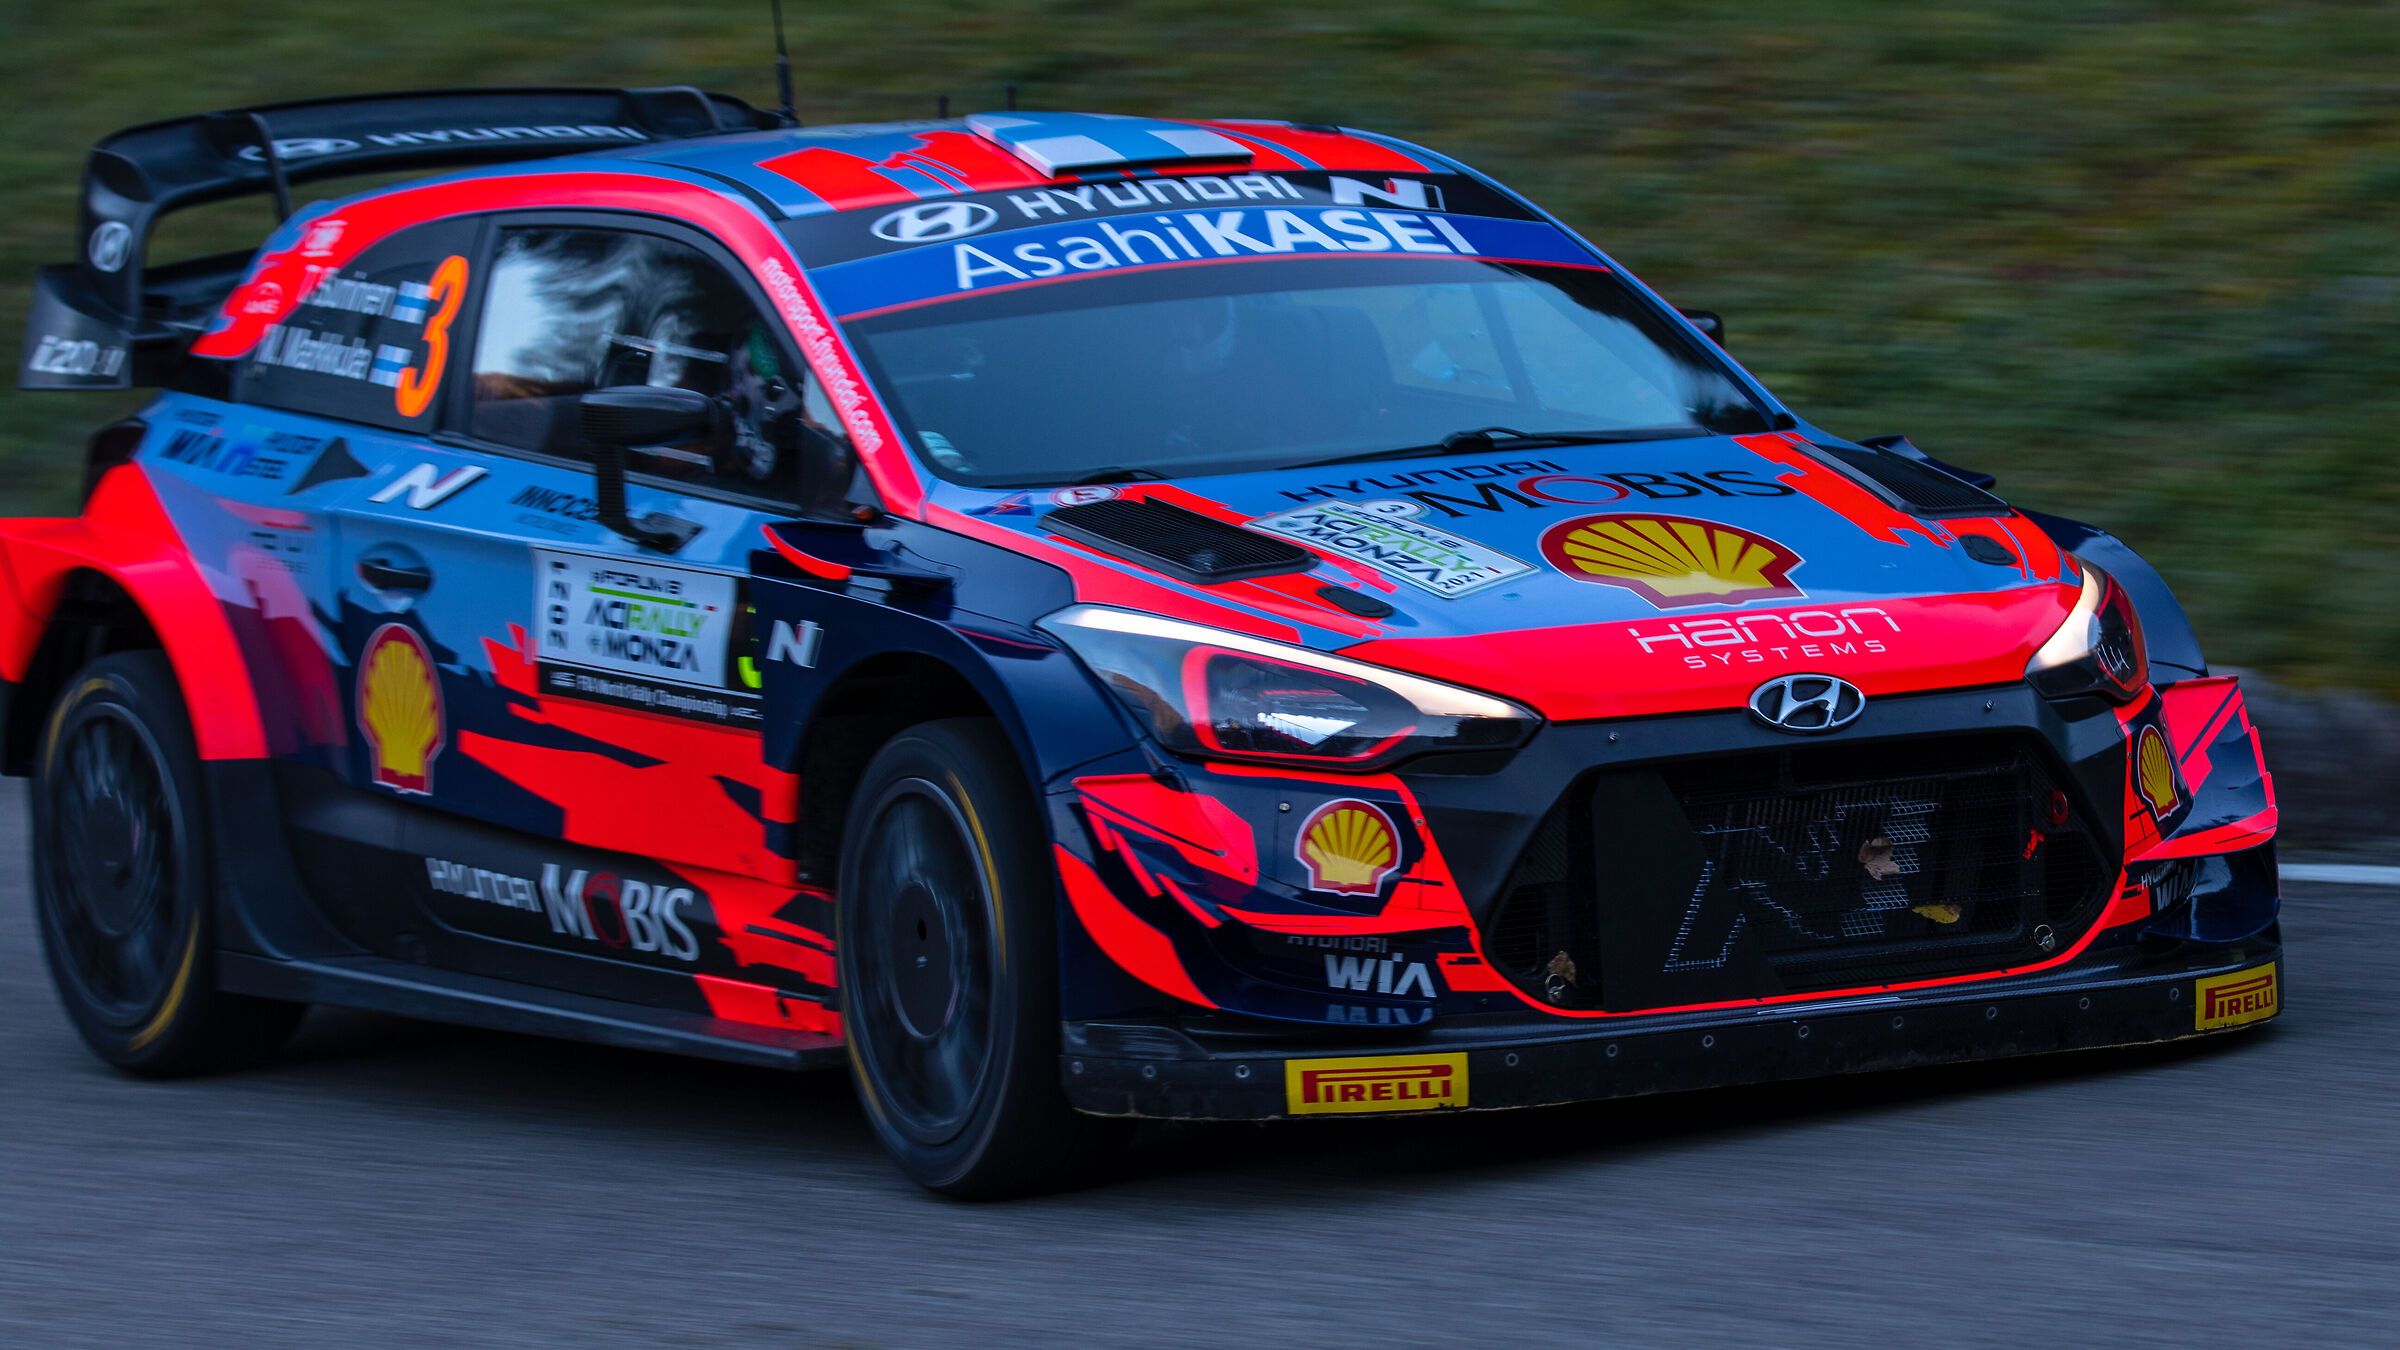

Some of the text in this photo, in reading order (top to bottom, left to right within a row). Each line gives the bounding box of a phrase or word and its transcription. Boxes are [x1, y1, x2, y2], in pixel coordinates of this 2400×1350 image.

[365, 125, 648, 146] HYUNDAI
[1006, 174, 1305, 219] HYUNDAI
[395, 255, 468, 417] 3
[1279, 459, 1568, 502] HYUNDAI
[1399, 470, 1797, 518] MOBIS
[1377, 503, 1405, 514] 3
[1294, 526, 1444, 584] MONZA
[1437, 570, 1486, 590] 2021
[602, 630, 701, 673] MONZA
[1683, 639, 1887, 669] SYSTEMS
[425, 857, 700, 962] HYUNDAI MOBIS
[2203, 973, 2274, 1020] PIRELLI
[1301, 1064, 1454, 1104] PIRELLI
